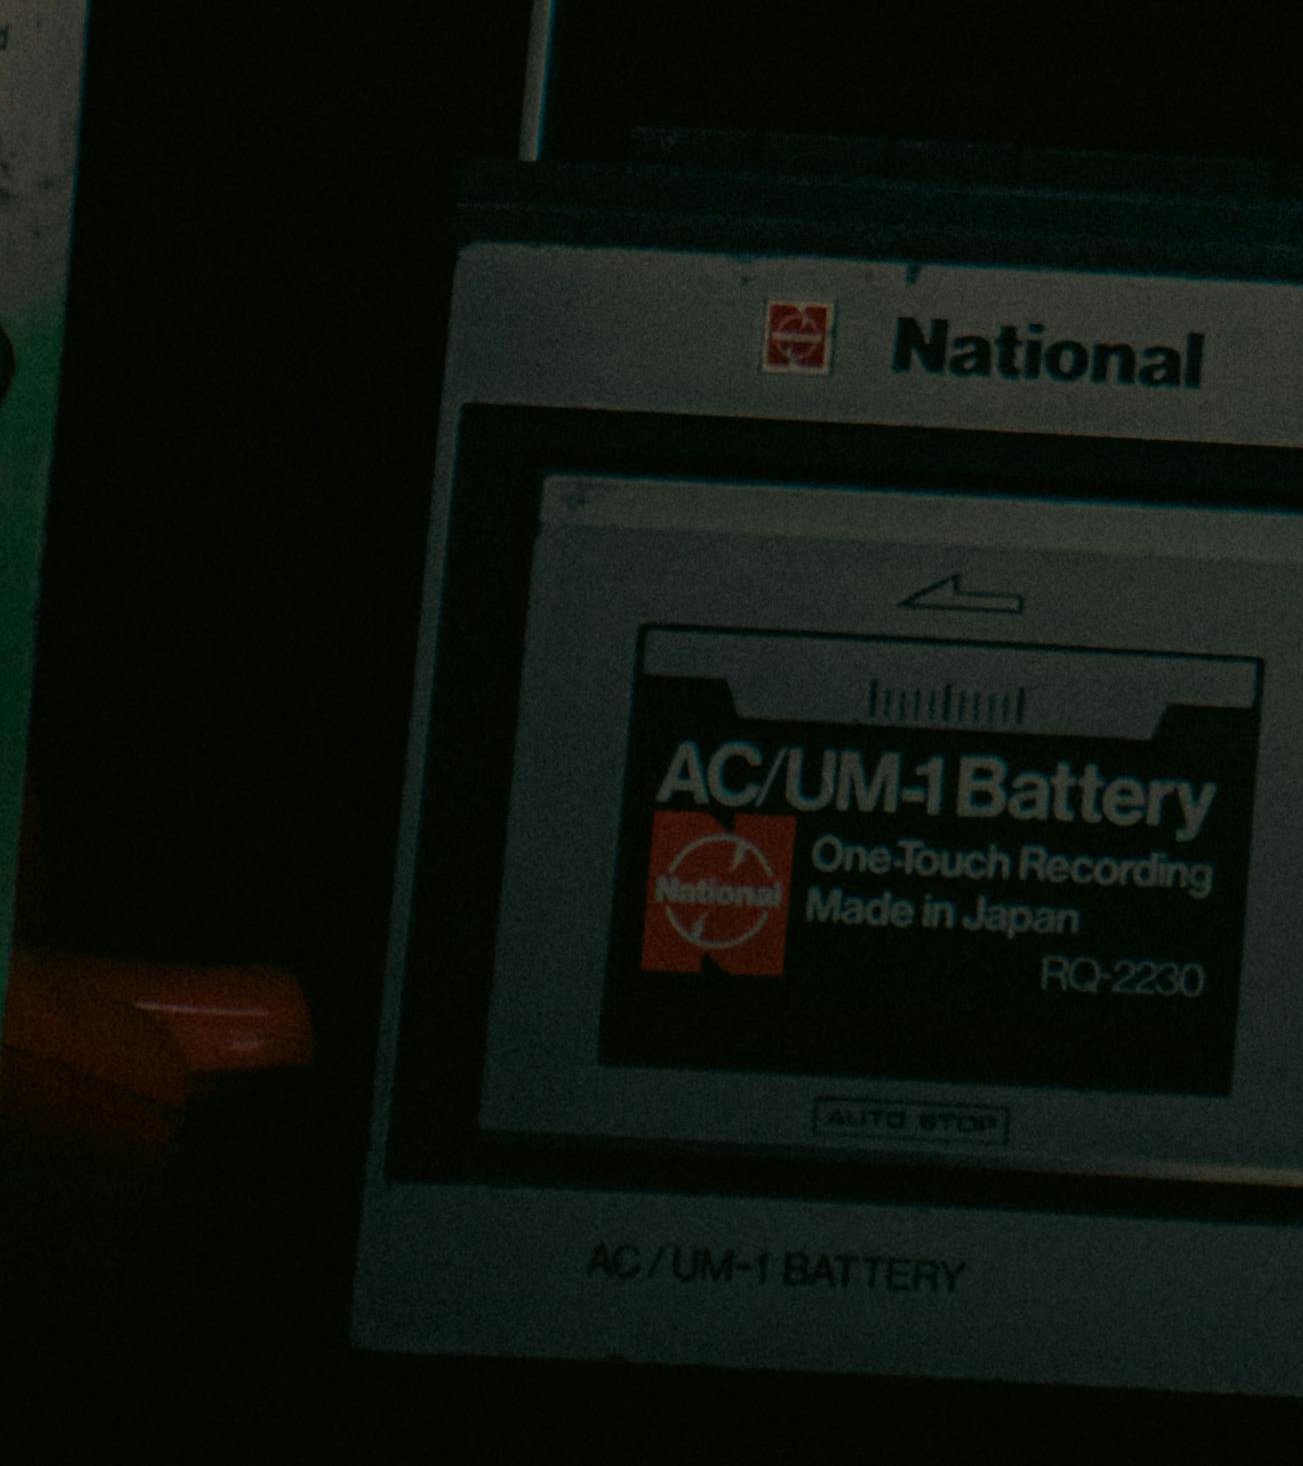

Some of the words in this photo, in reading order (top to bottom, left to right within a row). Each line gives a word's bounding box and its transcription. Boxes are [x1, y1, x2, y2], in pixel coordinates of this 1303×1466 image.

[892, 316, 1205, 389] National
[656, 738, 948, 816] AC/UM-1
[956, 754, 1219, 842] Battery
[812, 834, 1011, 881] One-Touch
[1018, 845, 1215, 900] Recording
[805, 886, 914, 929] Made
[922, 893, 957, 929] in
[963, 898, 1080, 939] Japan
[1039, 954, 1206, 998] RQ-2230
[826, 1109, 907, 1129] AUTO
[919, 1113, 997, 1133] STOP
[780, 1252, 967, 1294] BATTERY
